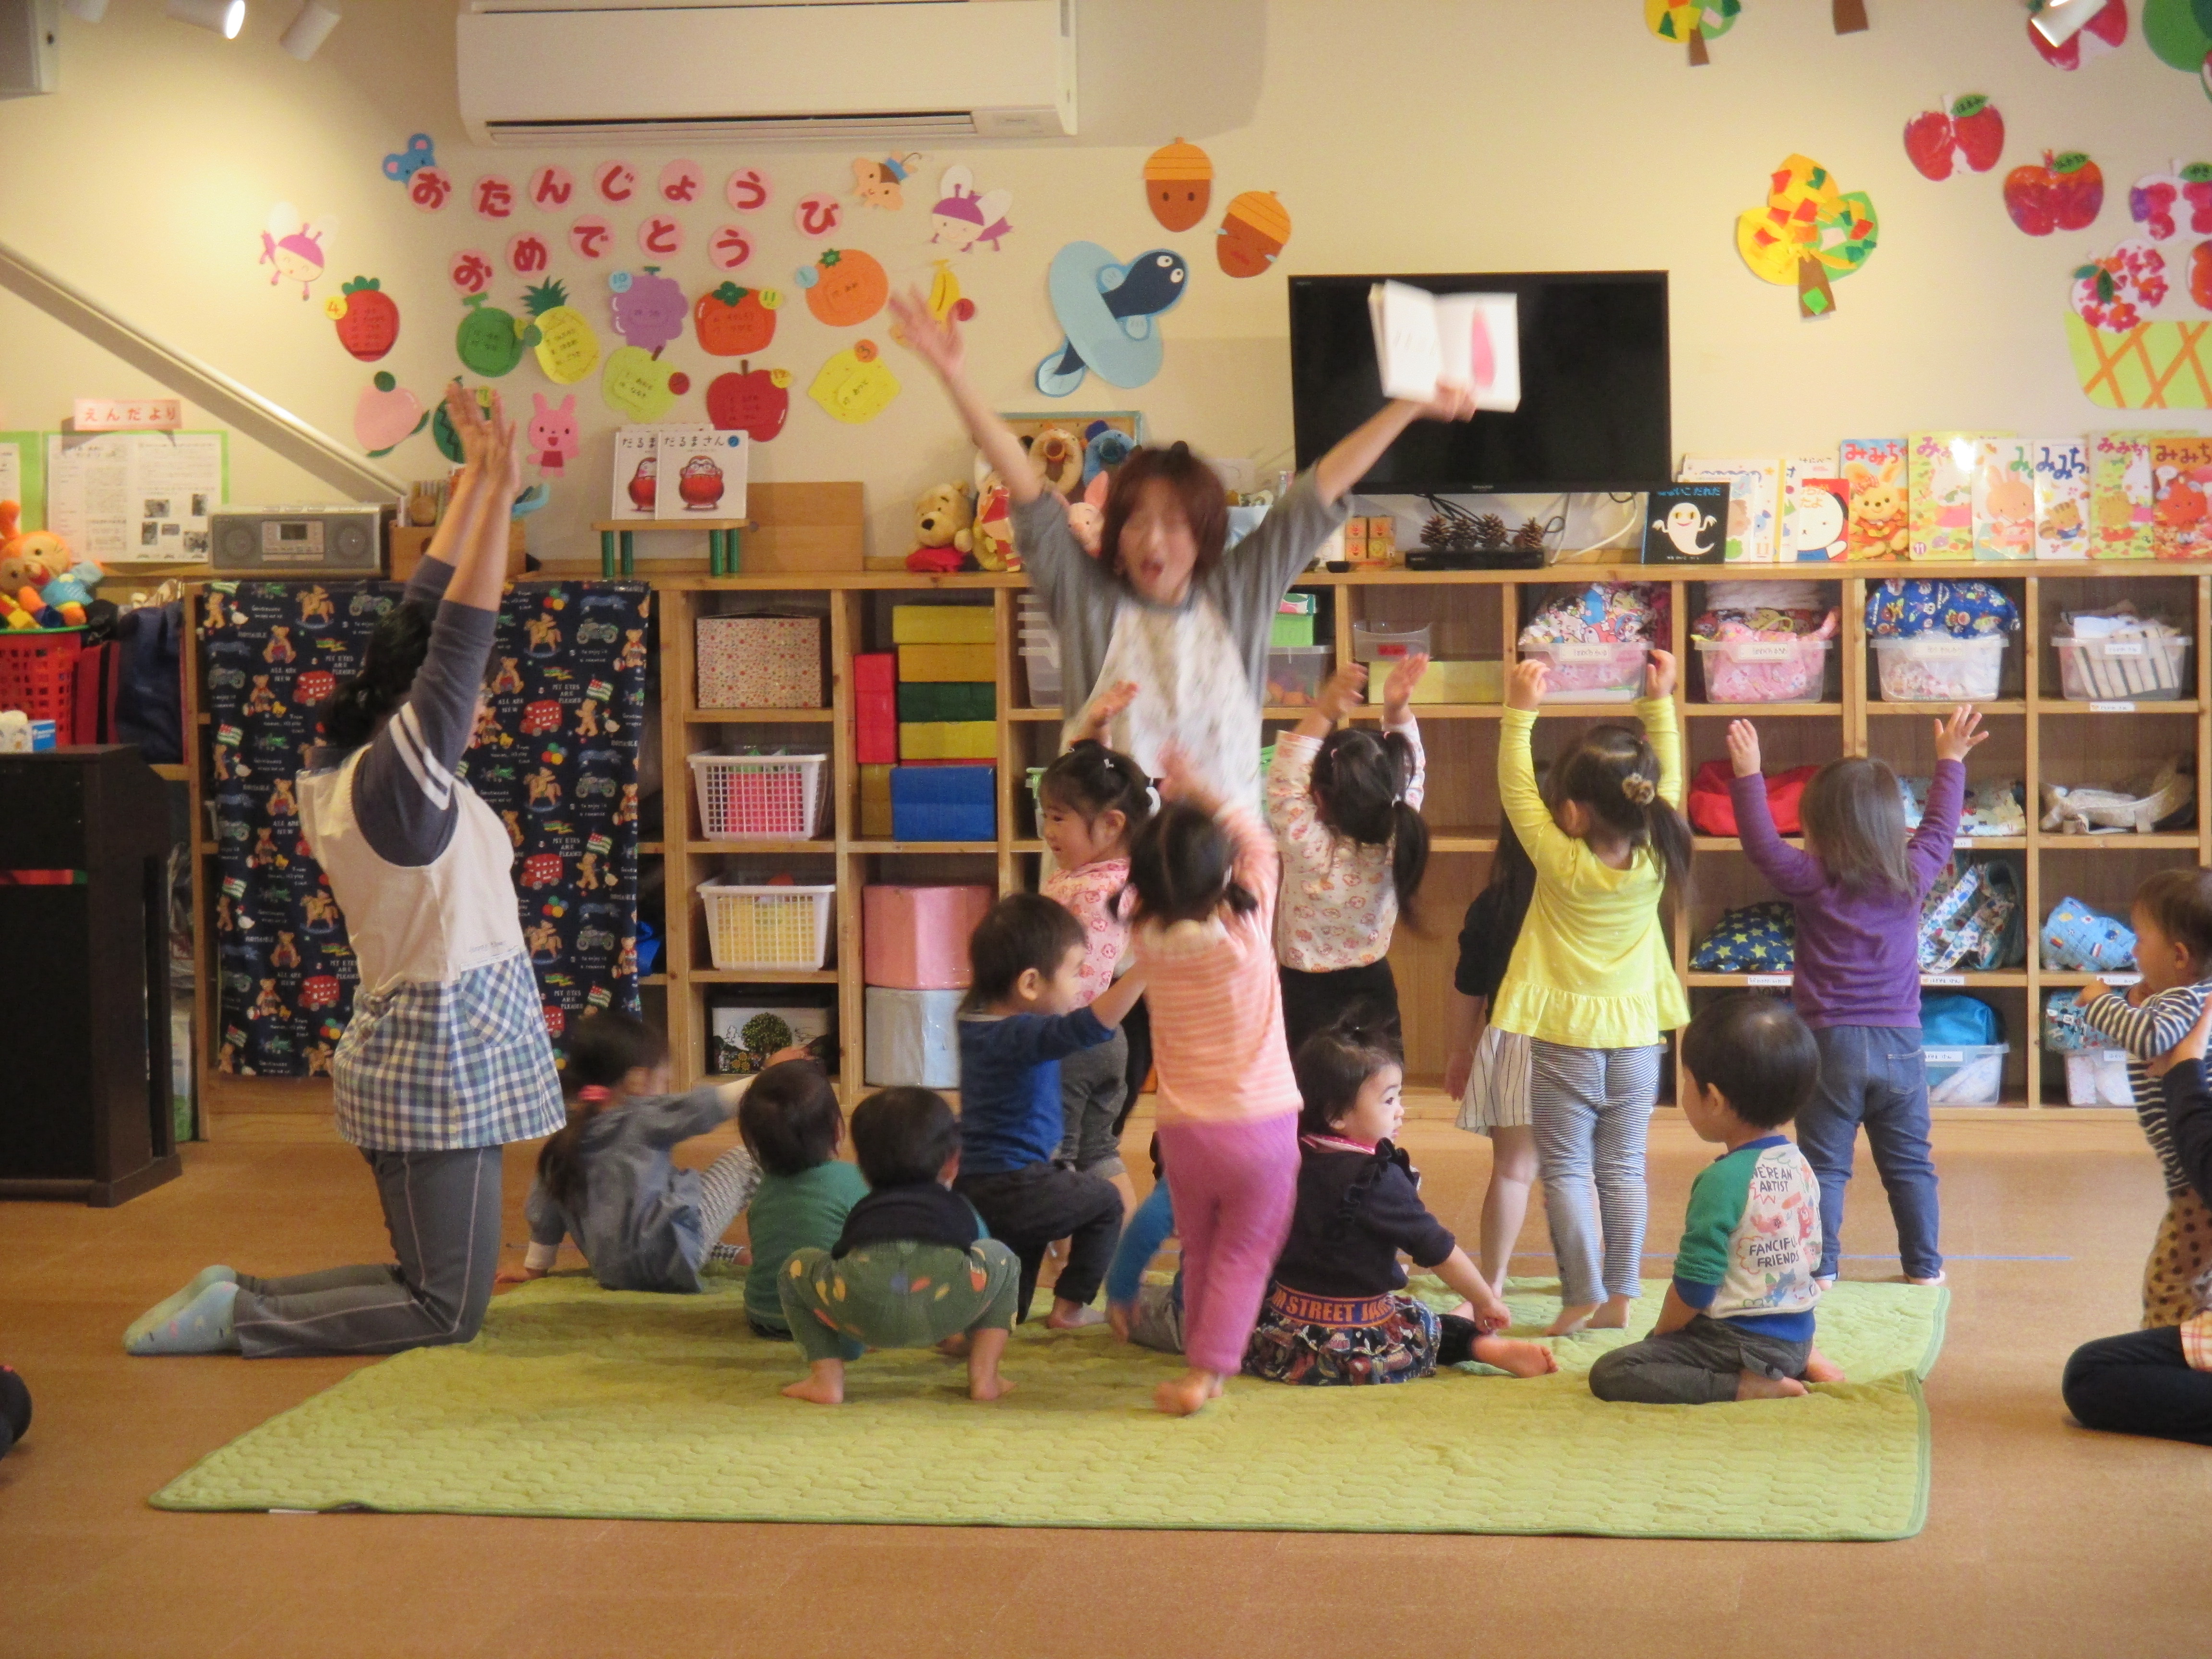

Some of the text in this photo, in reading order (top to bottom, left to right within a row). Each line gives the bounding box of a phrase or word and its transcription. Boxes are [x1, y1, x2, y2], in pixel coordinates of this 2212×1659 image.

[413, 165, 840, 235] おたんじょうび
[453, 219, 750, 292] おめでとう
[84, 407, 177, 421] えんだより
[1781, 1168, 1792, 1180] AN
[1760, 1180, 1788, 1192] ARTIST
[1757, 1250, 1799, 1267] FRIENDS
[1286, 1296, 1355, 1322] STREET
